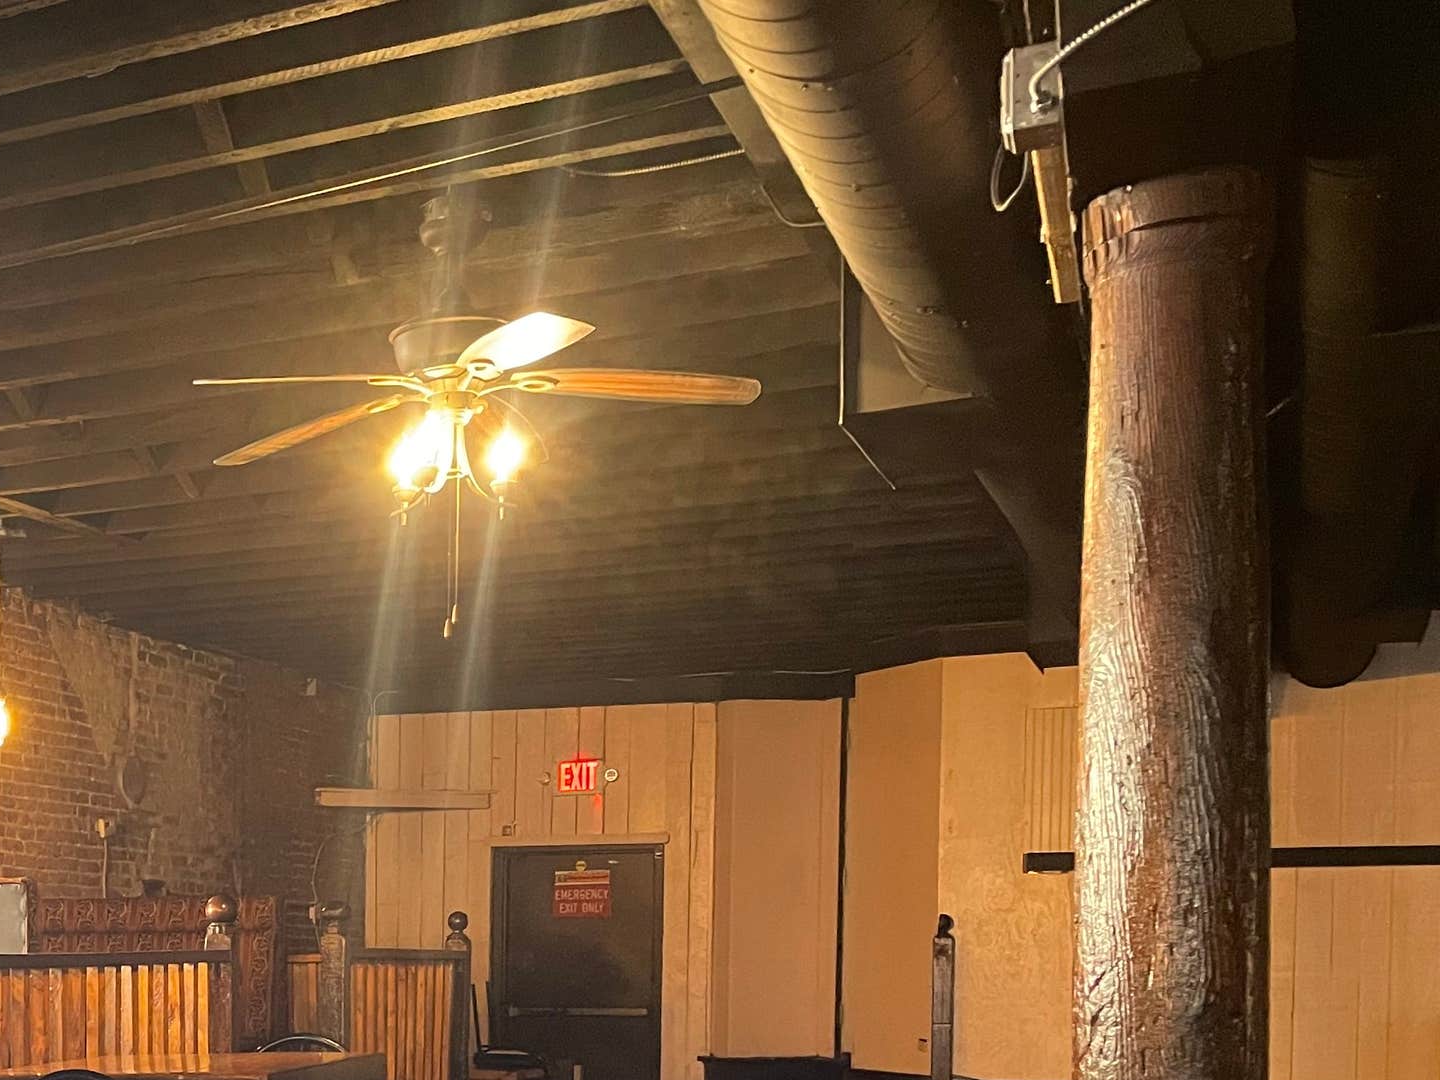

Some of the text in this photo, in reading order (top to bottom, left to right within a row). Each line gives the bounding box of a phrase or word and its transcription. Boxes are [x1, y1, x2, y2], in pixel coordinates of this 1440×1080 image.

[561, 762, 597, 790] EXIT
[555, 888, 608, 900] EMERGENCY
[560, 902, 604, 913] EXIT ONLY
